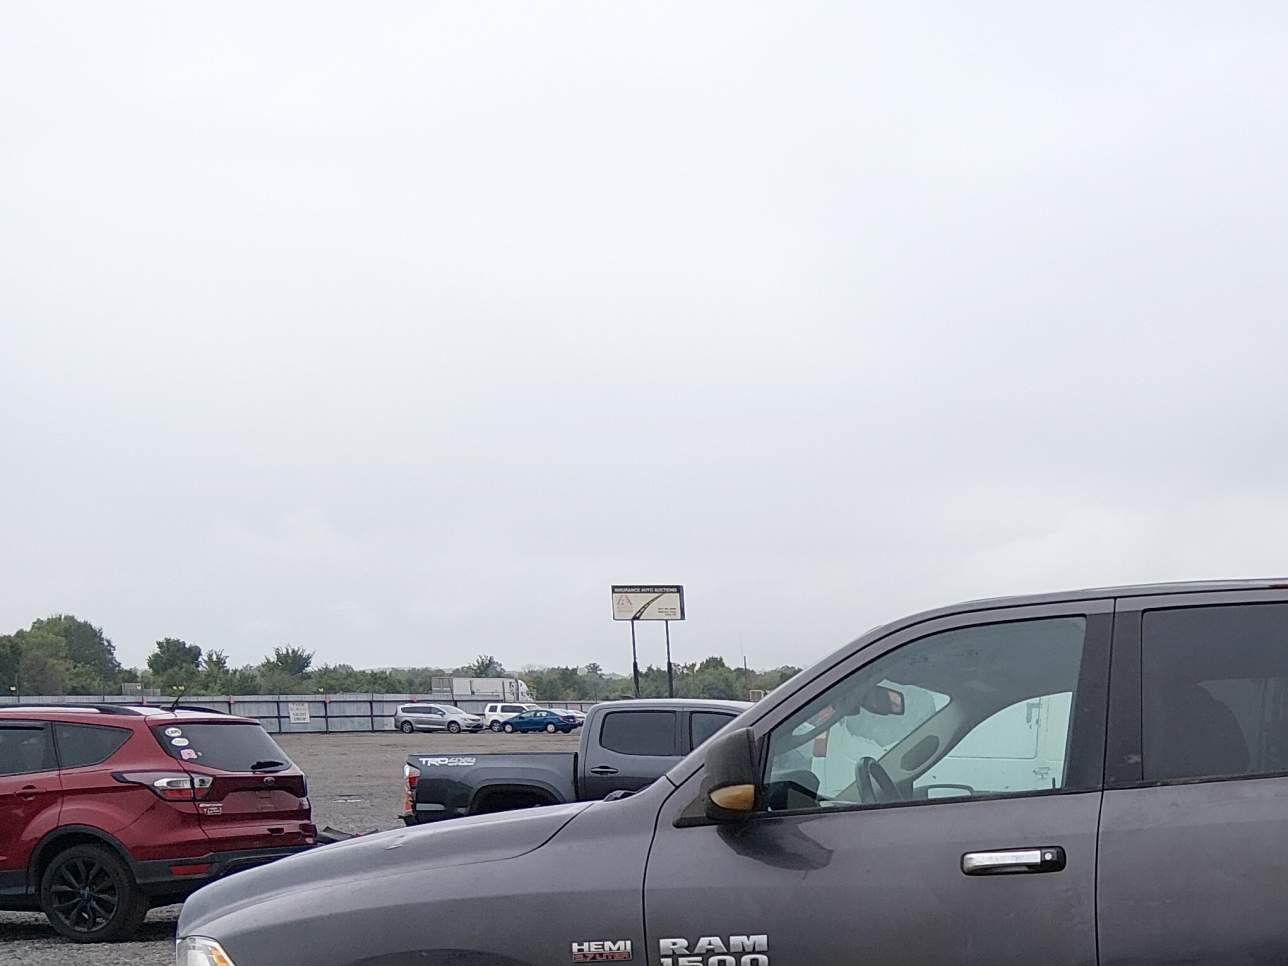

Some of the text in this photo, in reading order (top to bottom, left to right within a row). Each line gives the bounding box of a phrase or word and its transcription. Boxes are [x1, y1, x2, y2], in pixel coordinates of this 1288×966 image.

[418, 757, 449, 767] TRD
[571, 940, 632, 953] HEMI
[659, 934, 769, 955] RAM
